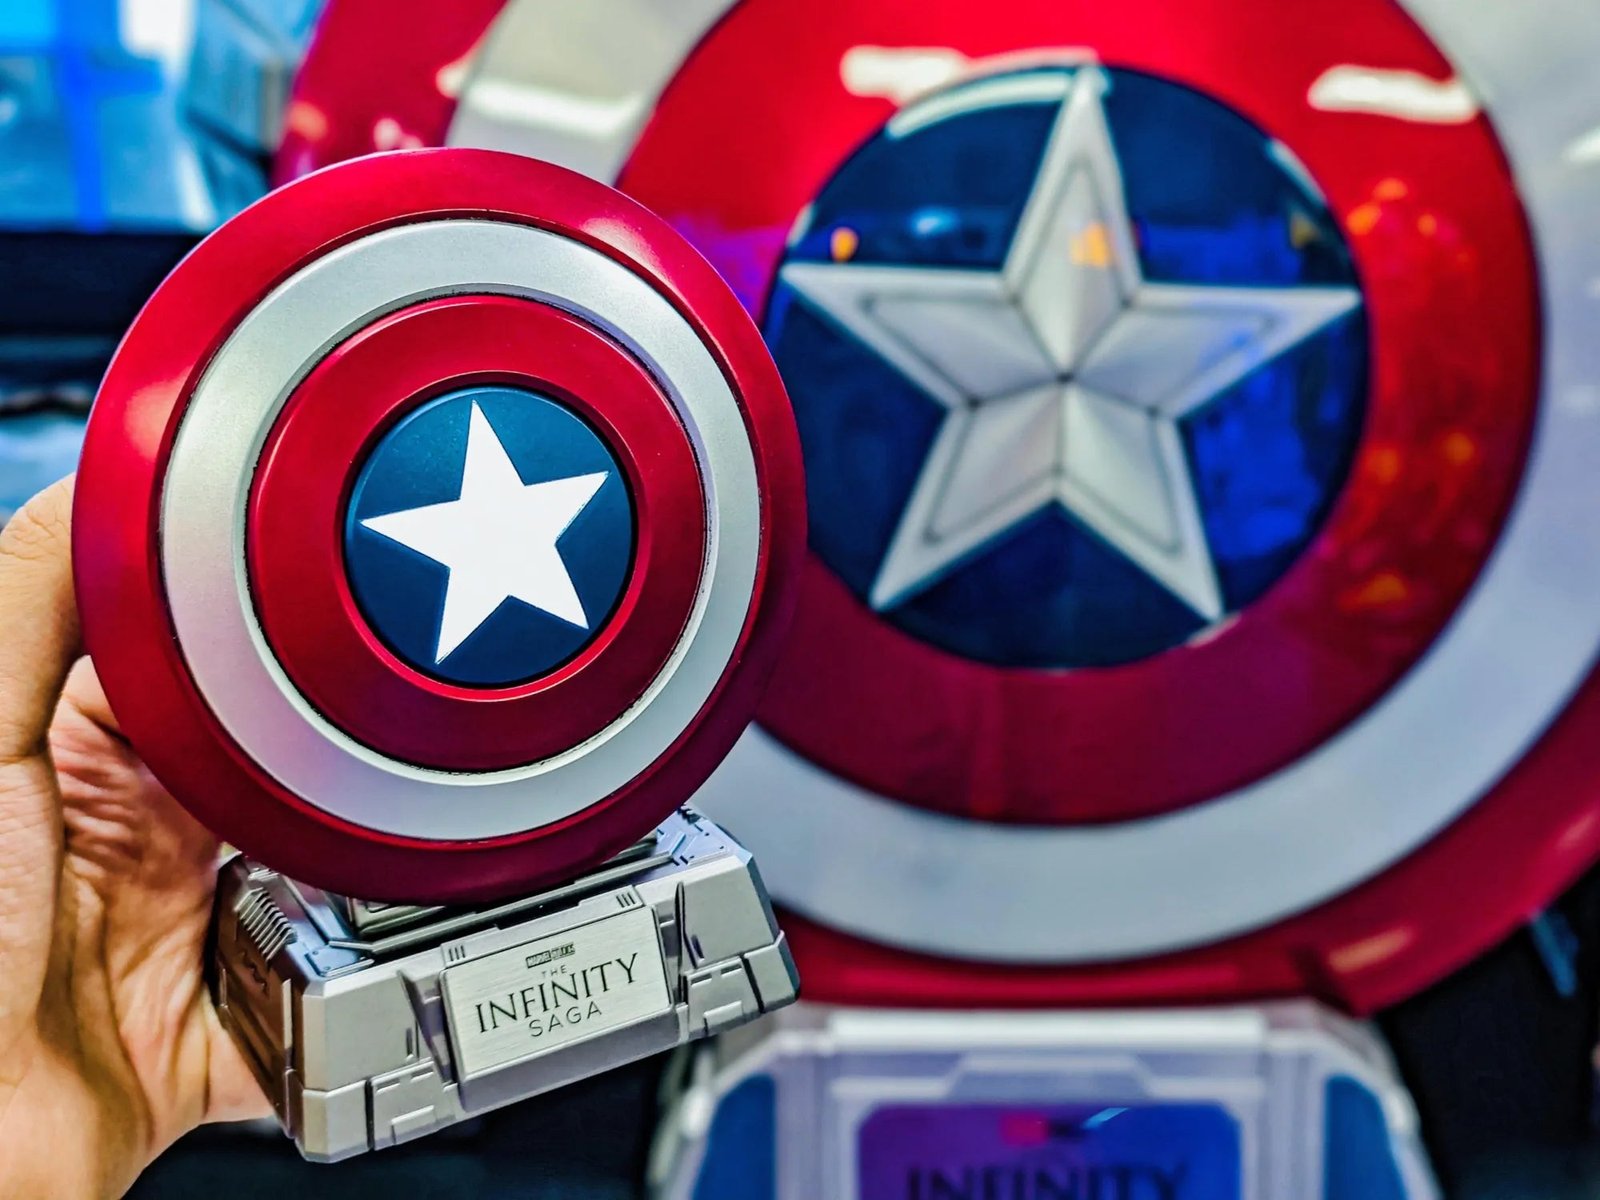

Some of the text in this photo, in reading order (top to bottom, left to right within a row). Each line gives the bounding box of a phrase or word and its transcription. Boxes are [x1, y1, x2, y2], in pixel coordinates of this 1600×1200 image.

[541, 965, 568, 978] THE
[475, 952, 638, 1033] INFINITY
[529, 1001, 602, 1037] SAGA
